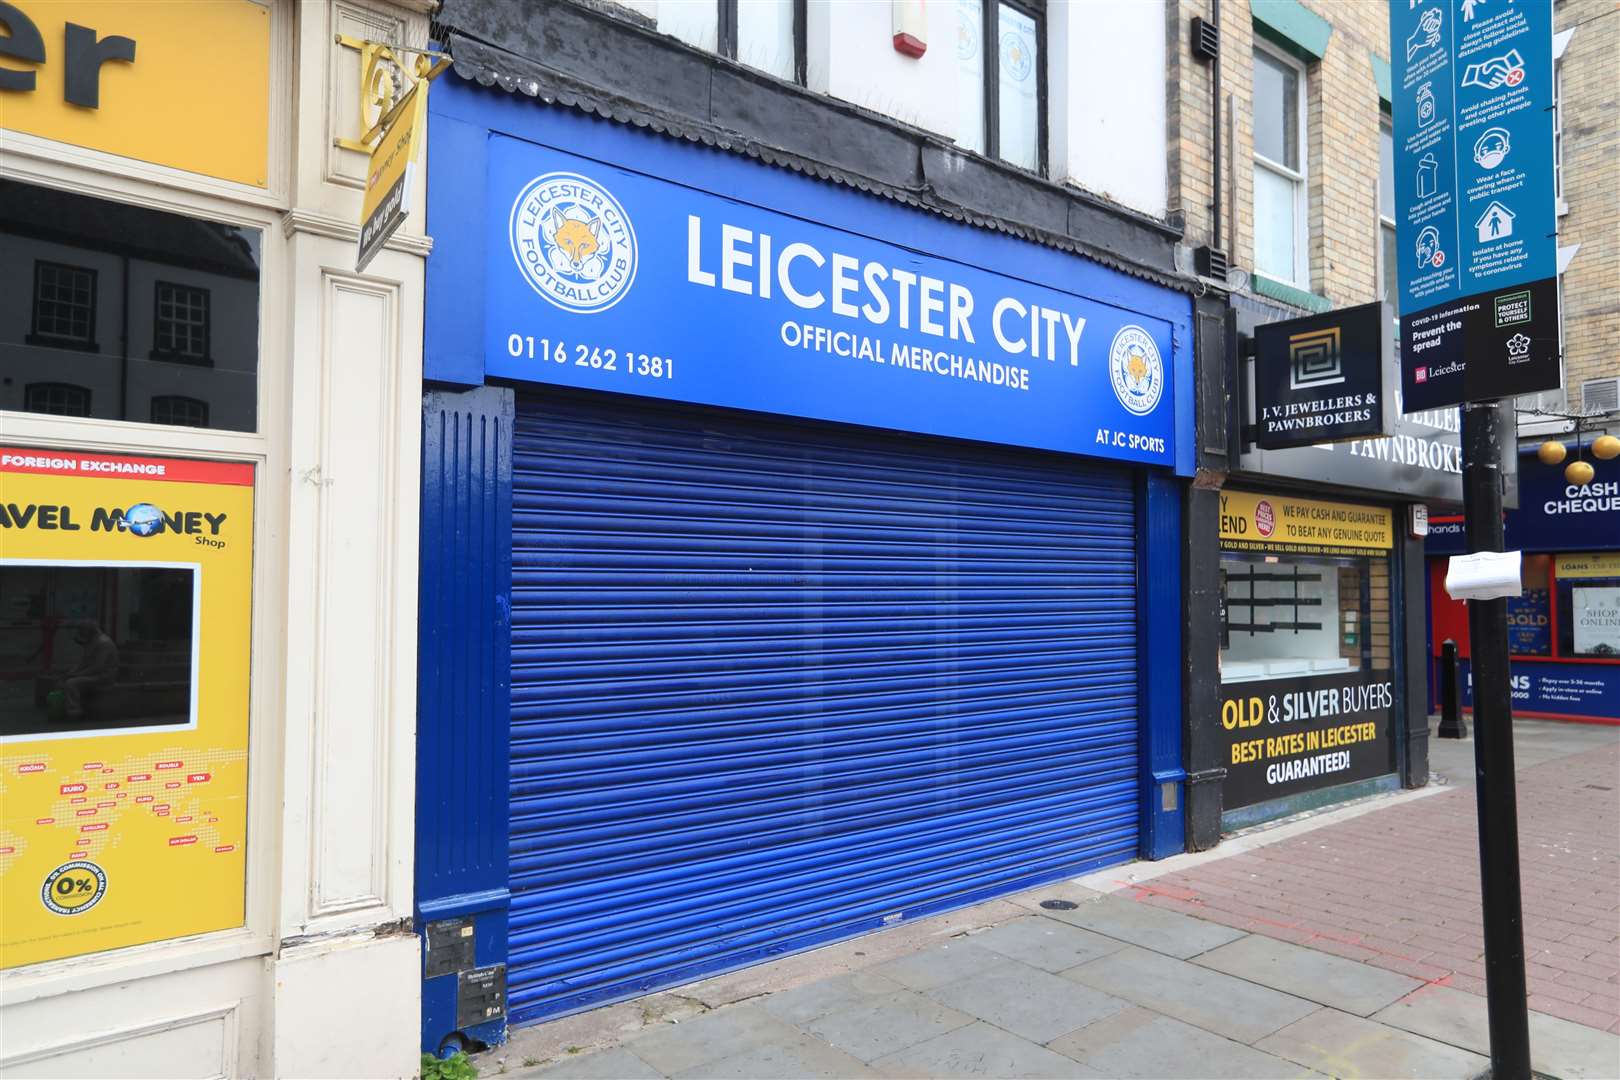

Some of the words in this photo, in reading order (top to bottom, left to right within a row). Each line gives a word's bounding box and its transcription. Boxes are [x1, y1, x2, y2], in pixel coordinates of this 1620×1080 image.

[1463, 30, 1481, 42] close
[1482, 19, 1508, 33] contact
[1509, 11, 1523, 23] and
[1472, 17, 1493, 30] Please
[1495, 8, 1514, 20] avoid
[1458, 40, 1492, 58] distancing
[1493, 26, 1530, 45] guidelines
[1460, 36, 1482, 50] always
[1483, 28, 1505, 40] follow
[1506, 18, 1527, 31] social
[1460, 103, 1480, 115] Avoid
[1480, 94, 1507, 108] shaking
[1507, 86, 1529, 98] hands
[1465, 112, 1478, 121] and
[1478, 102, 1504, 116] contact
[1505, 95, 1525, 106] when
[1458, 117, 1487, 131] greeting
[1487, 109, 1506, 120] other
[1506, 100, 1532, 115] people
[1466, 182, 1496, 195] covering
[1496, 176, 1515, 186] when
[1515, 172, 1526, 180] on
[1475, 174, 1494, 184] Wear
[1500, 168, 1516, 177] face
[1469, 190, 1491, 203] public
[1490, 180, 1524, 195] transport
[522, 184, 604, 228] LEICESTER
[604, 208, 628, 250] CITY
[1472, 246, 1495, 257] Isolate
[1503, 239, 1524, 249] home
[1480, 255, 1492, 264] you
[1492, 250, 1509, 259] have
[1510, 247, 1523, 256] any
[522, 238, 598, 301] FOOTBALL
[1468, 259, 1503, 273] symptoms
[1503, 252, 1529, 264] related
[1483, 262, 1522, 277] coronavirus
[597, 256, 628, 297] CLUB
[687, 214, 976, 344] LEICESTER
[992, 297, 1087, 366] CITY
[1498, 300, 1528, 312] PROTECT
[1498, 307, 1528, 318] YOURSELF
[1411, 314, 1439, 328] COVID-19
[1504, 313, 1528, 322] OTHERS
[1412, 323, 1446, 341] Prevent
[1446, 319, 1462, 332] the
[507, 332, 568, 365] 0116
[575, 344, 617, 372] 262
[626, 352, 673, 379] 1381
[1412, 336, 1441, 353] spread
[781, 321, 885, 364] OFFICIAL
[891, 342, 1029, 391] MERCHANDISE
[1148, 344, 1160, 374] CITY
[1429, 360, 1467, 378] Leicester
[1262, 407, 1270, 420] J.
[1271, 404, 1283, 417] V.
[1284, 393, 1362, 416] JEWELLERS
[1366, 393, 1377, 405] &
[1267, 409, 1371, 432] PAWNBROKERS
[1096, 429, 1110, 445] AT
[1112, 431, 1126, 447] JC
[1128, 433, 1165, 453] SPORTS
[2, 455, 76, 469] FOREIGN
[80, 460, 166, 475] EXCHANGE
[1565, 482, 1618, 498] CASH
[1283, 505, 1295, 518] WE
[1296, 506, 1310, 519] PAY
[1311, 509, 1331, 521] CASH
[1331, 512, 1348, 523] AND
[1348, 513, 1386, 527] GUARANTEE
[1544, 497, 1620, 514] CHEQUE
[1219, 515, 1247, 534] END
[1286, 524, 1296, 537] TO
[1298, 525, 1317, 538] BEAT
[1317, 528, 1333, 539] ANY
[1333, 529, 1363, 542] GENUINE
[1364, 531, 1385, 543] QUOTE
[1428, 523, 1460, 534] hands
[195, 535, 226, 549] Shop
[1224, 541, 1237, 549] GOLD
[1586, 608, 1618, 618] SHOP
[1267, 695, 1280, 724] &
[1283, 688, 1340, 722] SILVER
[1342, 682, 1392, 713] BUYERS
[1231, 739, 1265, 765] BEST
[1266, 733, 1304, 758] RATES
[1306, 729, 1319, 751] IN
[1321, 721, 1376, 748] LEICESTER
[1266, 750, 1350, 785] GUARANTEED!
[62, 784, 85, 794] EURO
[59, 862, 99, 874] COMMISSION
[56, 876, 93, 895] 0%
